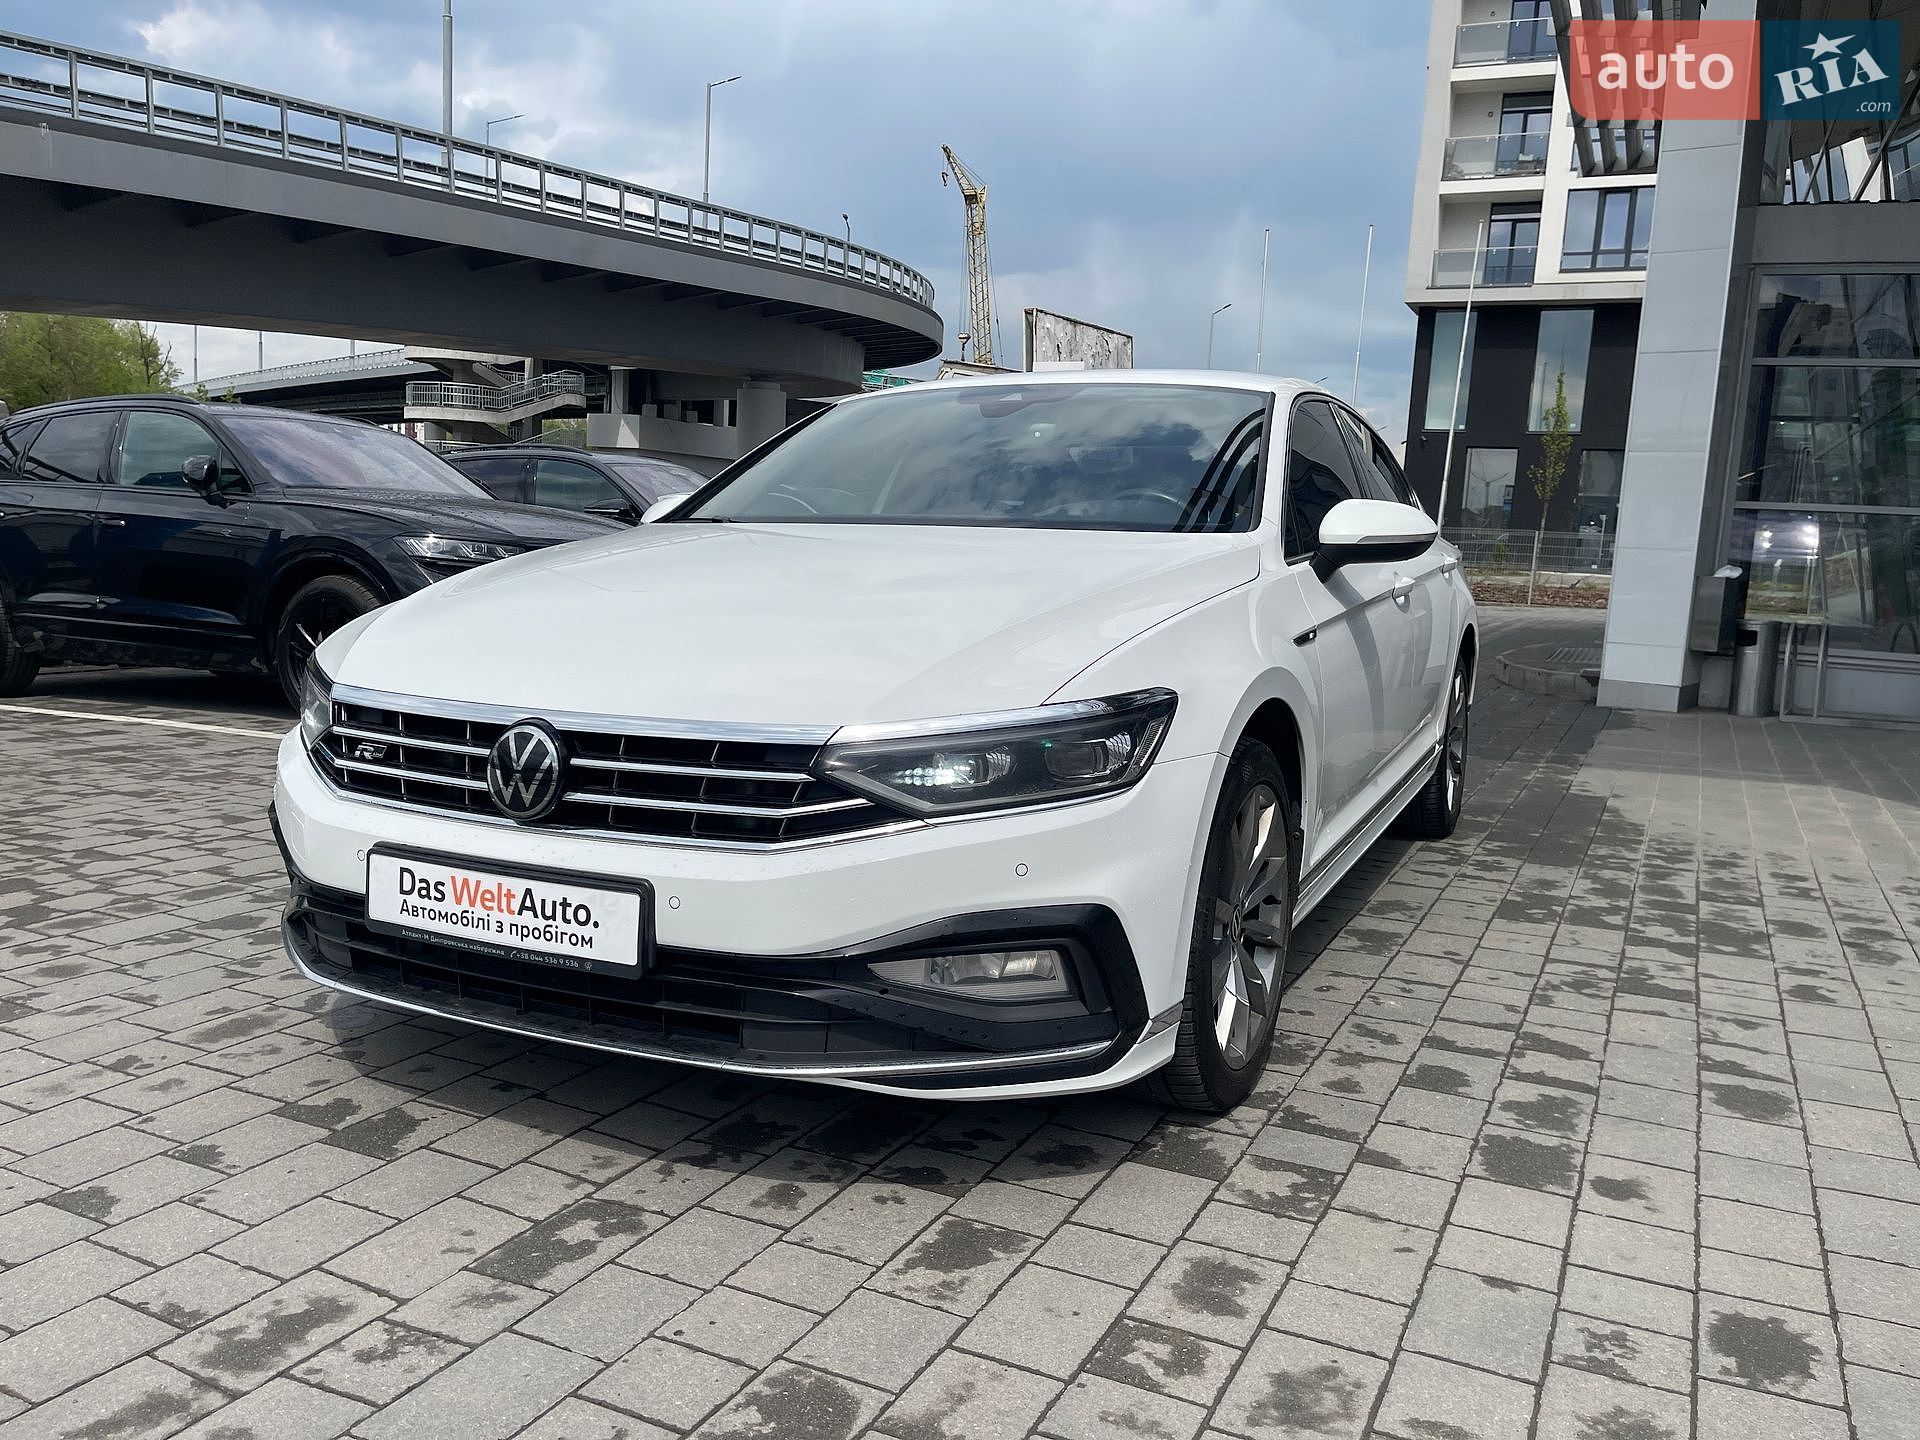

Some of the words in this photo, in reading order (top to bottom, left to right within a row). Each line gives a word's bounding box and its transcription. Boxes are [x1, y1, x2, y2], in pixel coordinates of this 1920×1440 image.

[399, 866, 447, 902] Das
[399, 898, 491, 933] Автомобілі
[495, 920, 504, 934] з
[509, 920, 593, 949] пробігом
